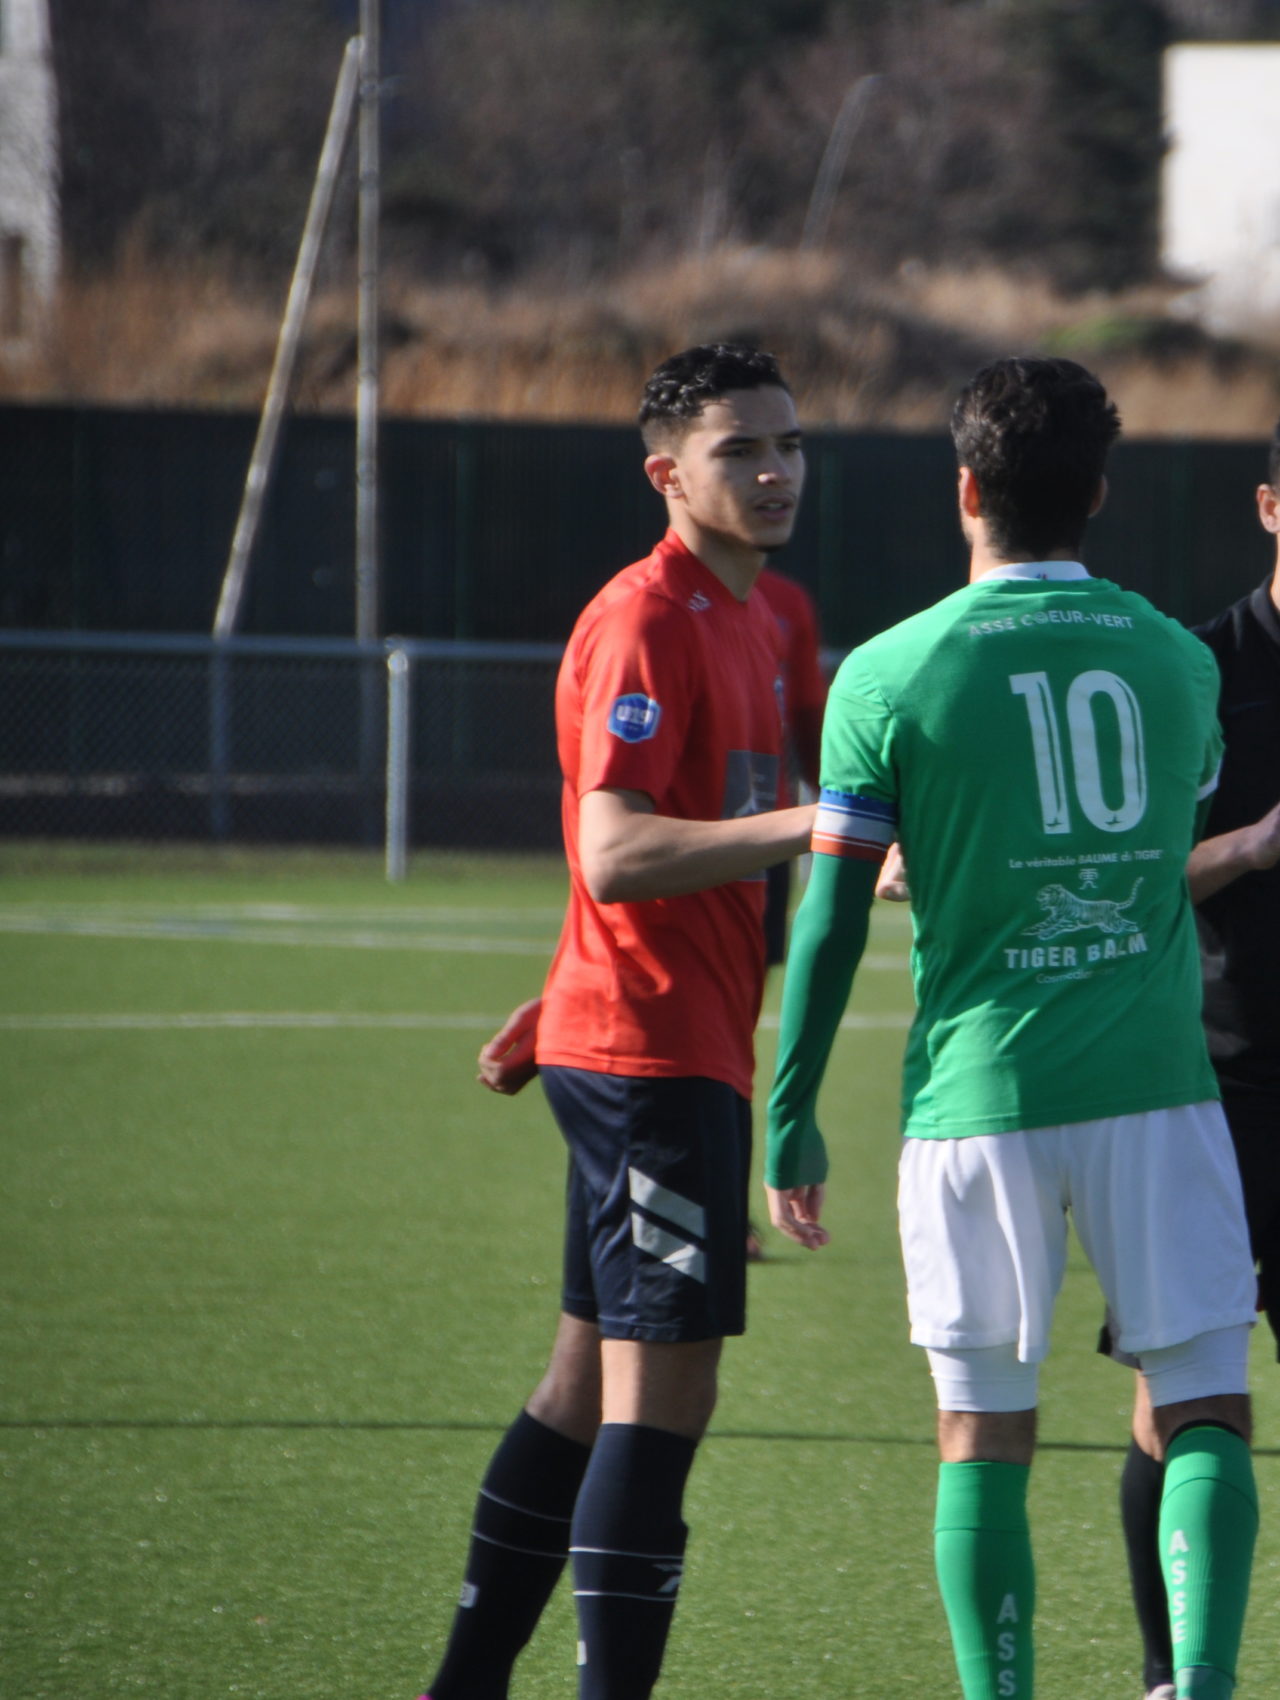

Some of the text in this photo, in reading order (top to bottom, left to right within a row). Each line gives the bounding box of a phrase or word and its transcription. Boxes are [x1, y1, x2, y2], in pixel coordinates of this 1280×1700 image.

[969, 616, 1017, 637] ASSE
[1009, 669, 1147, 834] 10
[1008, 858, 1023, 868] Le
[1078, 853, 1118, 864] BAUME
[1135, 849, 1163, 860] TIGRE
[1005, 933, 1147, 969] TIGER BALM
[1168, 1529, 1190, 1644] ASSE
